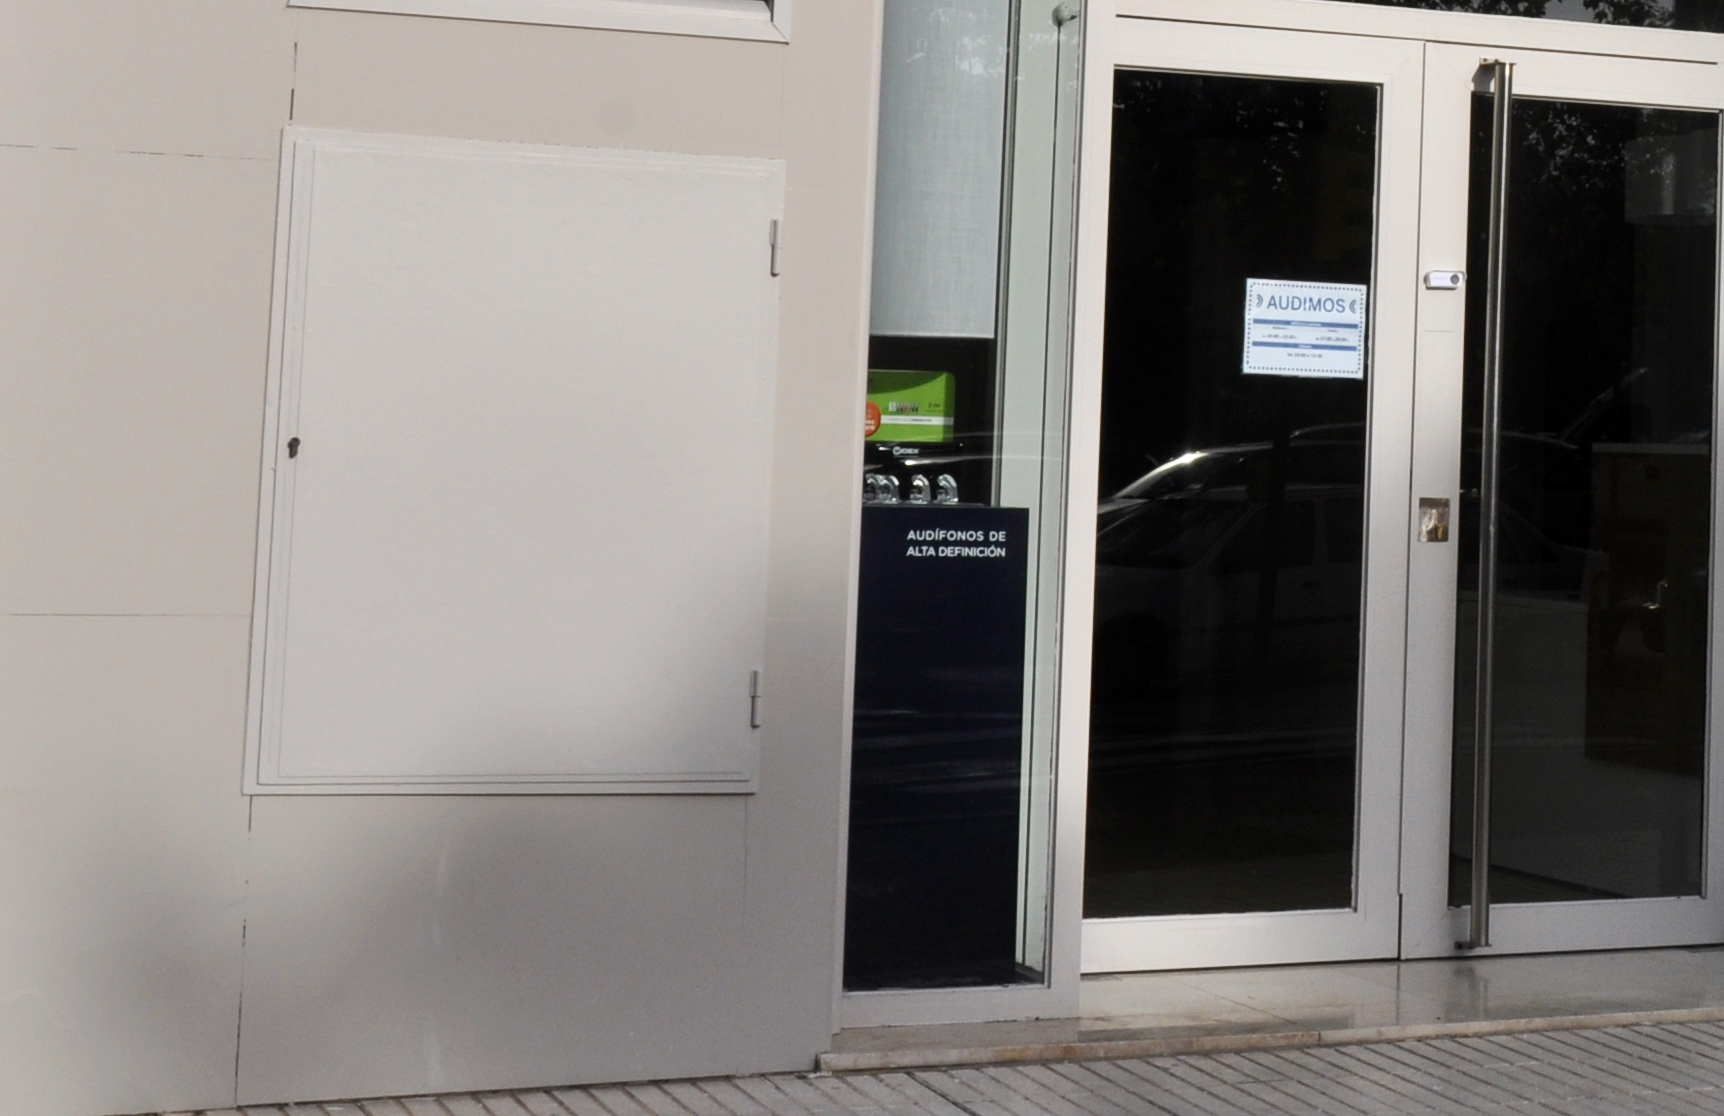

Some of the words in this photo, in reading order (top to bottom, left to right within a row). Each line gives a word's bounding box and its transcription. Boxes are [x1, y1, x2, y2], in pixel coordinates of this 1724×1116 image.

[1266, 294, 1346, 314] AUDIMOS
[906, 528, 985, 541] AUDÍFONOS
[989, 530, 1007, 541] DE
[906, 545, 936, 557] ALTA
[938, 544, 1006, 558] DEFINICIÓN
